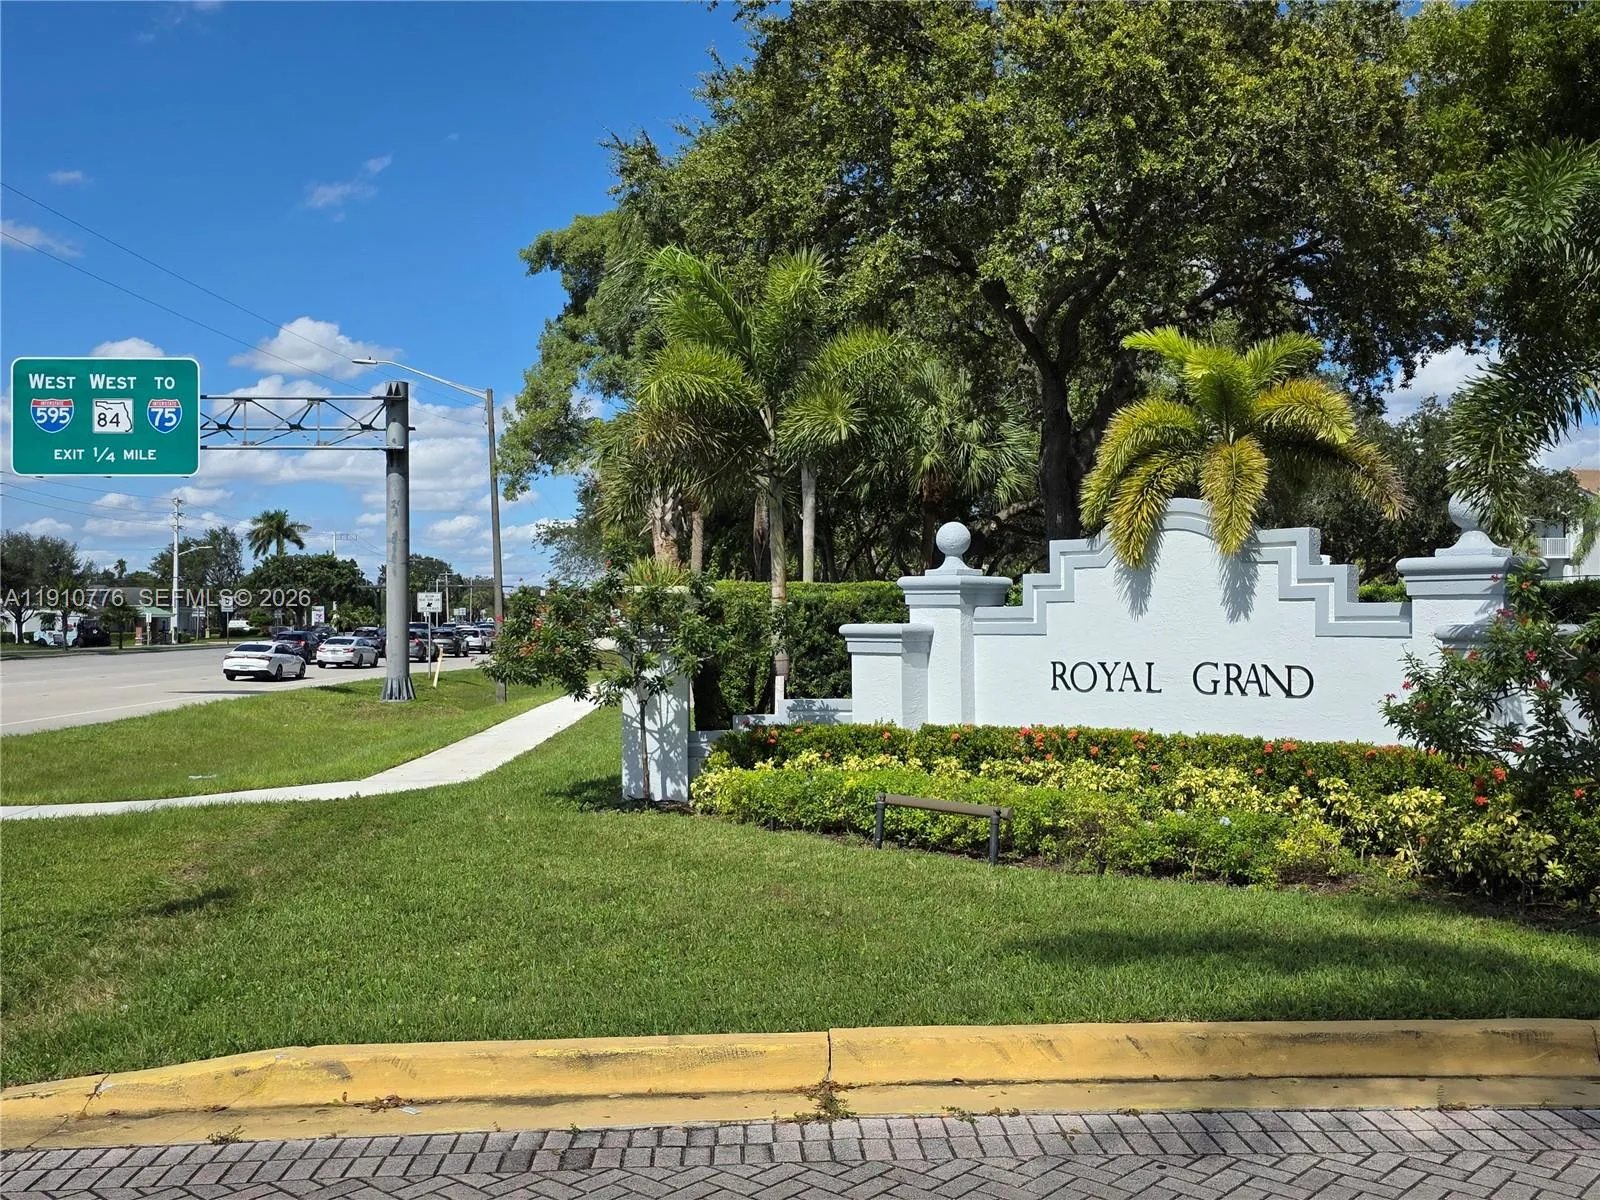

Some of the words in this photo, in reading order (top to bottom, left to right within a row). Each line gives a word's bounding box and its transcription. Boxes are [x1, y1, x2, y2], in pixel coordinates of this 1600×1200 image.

[29, 374, 76, 389] WEST
[90, 374, 137, 389] WEST
[154, 377, 175, 389] TO
[36, 408, 70, 424] 595
[97, 412, 120, 427] 84
[151, 408, 177, 426] 75
[54, 450, 84, 460] EXIT
[124, 450, 156, 460] MILE
[1051, 661, 1162, 693] ROYAL
[1192, 662, 1314, 698] GRAND
